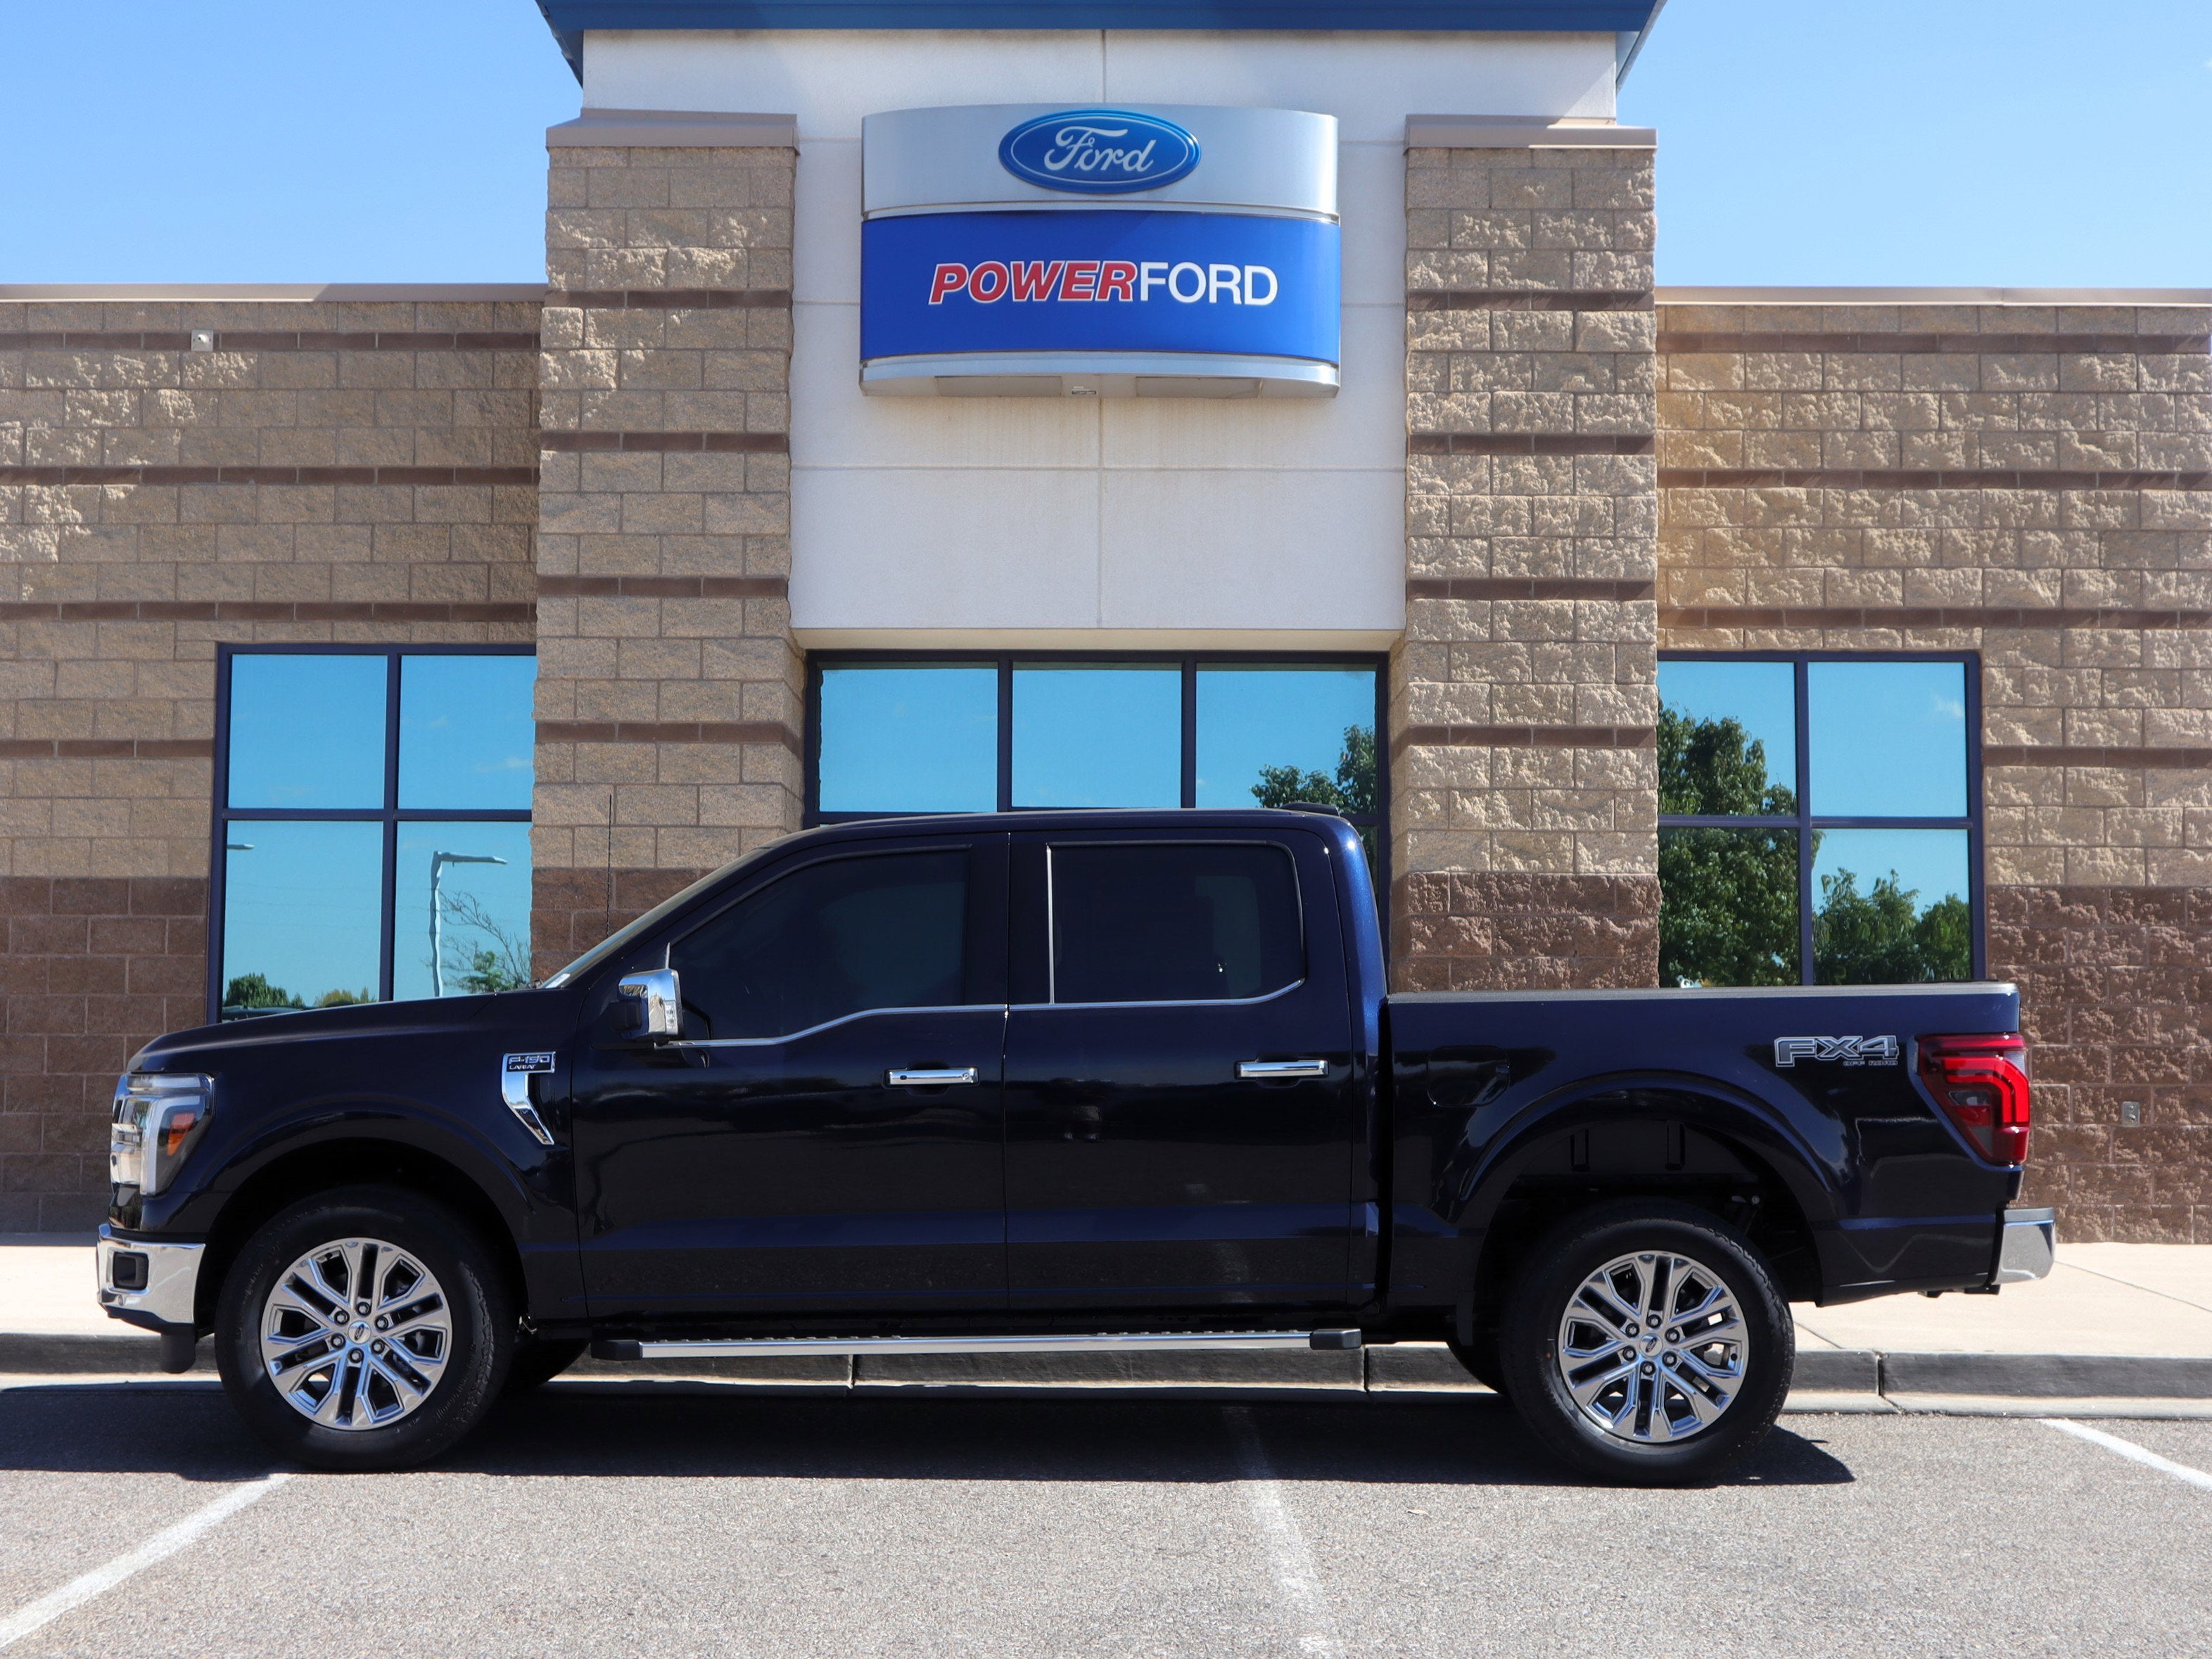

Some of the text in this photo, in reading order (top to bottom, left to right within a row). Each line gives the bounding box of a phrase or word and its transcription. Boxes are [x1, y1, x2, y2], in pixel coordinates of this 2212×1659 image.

[1044, 125, 1156, 172] Ford
[509, 1055, 550, 1064] F-150
[1774, 1035, 1899, 1067] FX4
